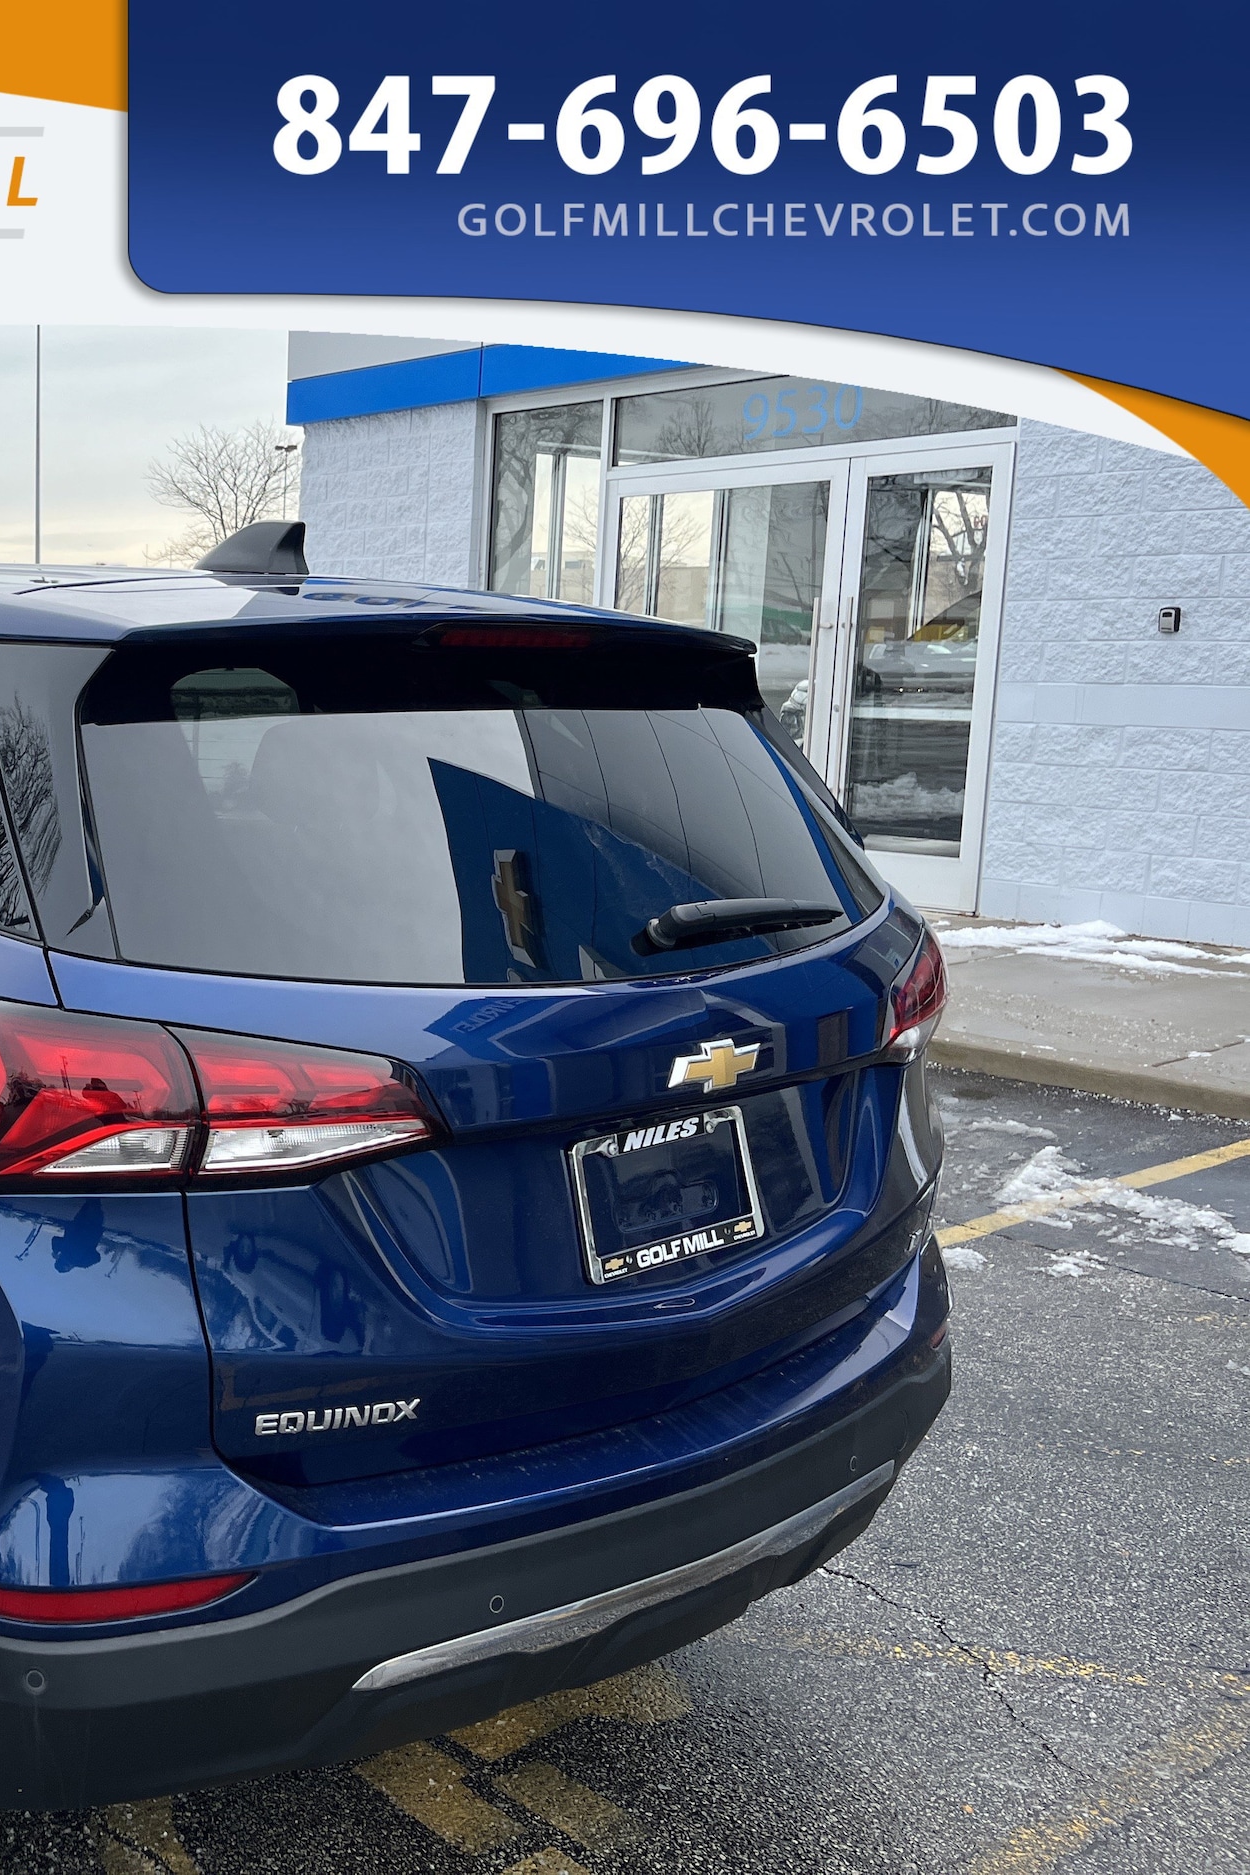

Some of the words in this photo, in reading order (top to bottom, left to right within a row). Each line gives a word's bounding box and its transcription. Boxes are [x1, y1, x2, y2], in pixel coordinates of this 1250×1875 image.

[742, 384, 864, 441] 9530
[623, 1117, 700, 1153] NILES
[636, 1243, 682, 1269] GOLF
[682, 1229, 725, 1255] MILL
[254, 1398, 421, 1436] EQUINOX
